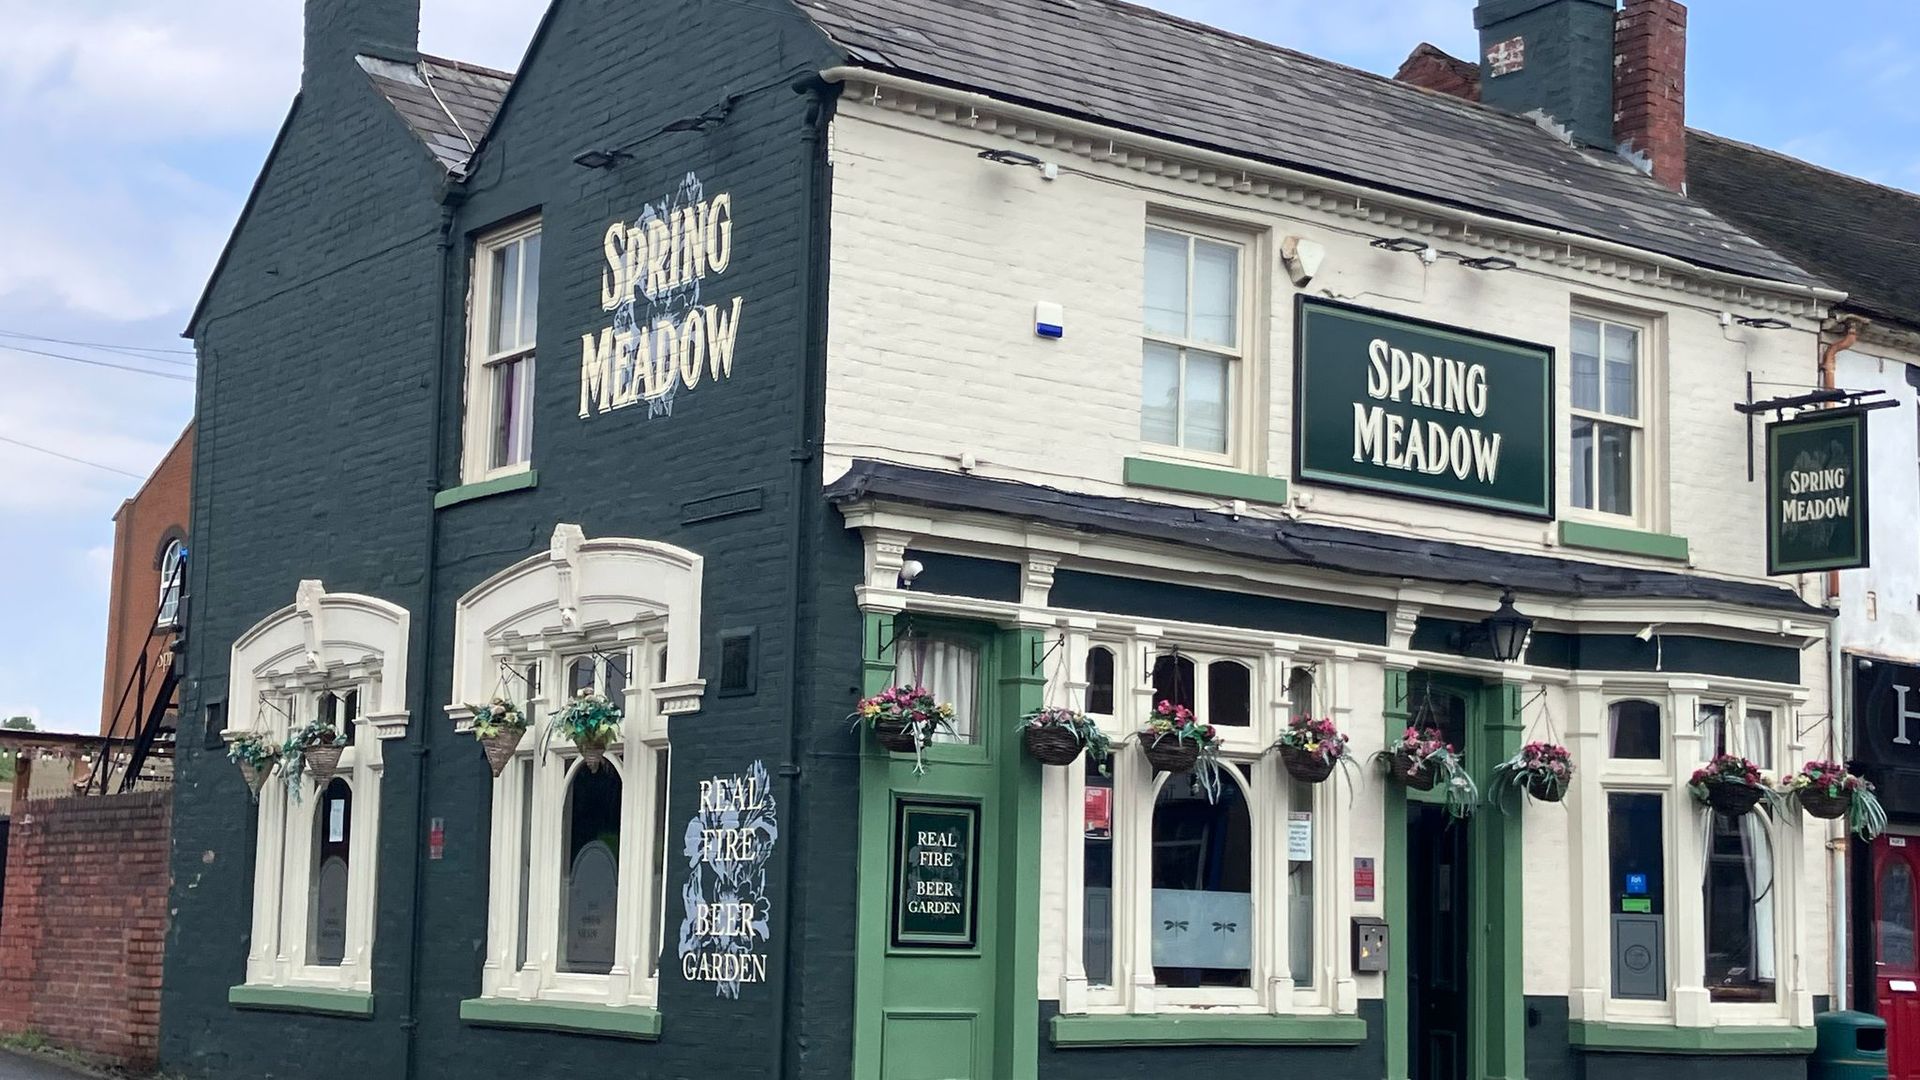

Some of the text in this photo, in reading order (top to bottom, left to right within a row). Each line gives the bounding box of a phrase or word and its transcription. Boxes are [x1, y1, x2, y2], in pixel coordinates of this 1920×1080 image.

[602, 192, 732, 313] SPRING
[578, 296, 743, 419] MEADOW
[1368, 338, 1488, 418] SPRING
[1352, 402, 1501, 484] MEADOW
[1790, 467, 1845, 495] SPRING
[1782, 496, 1850, 523] MEADOW
[698, 776, 764, 813] REAL
[701, 827, 757, 862] FIRE
[917, 831, 957, 848] REAL
[919, 851, 954, 867] FIRE
[916, 881, 954, 897] BEER
[695, 902, 756, 937] BEER
[908, 901, 961, 915] GARDEN
[683, 951, 767, 983] GARDEN
